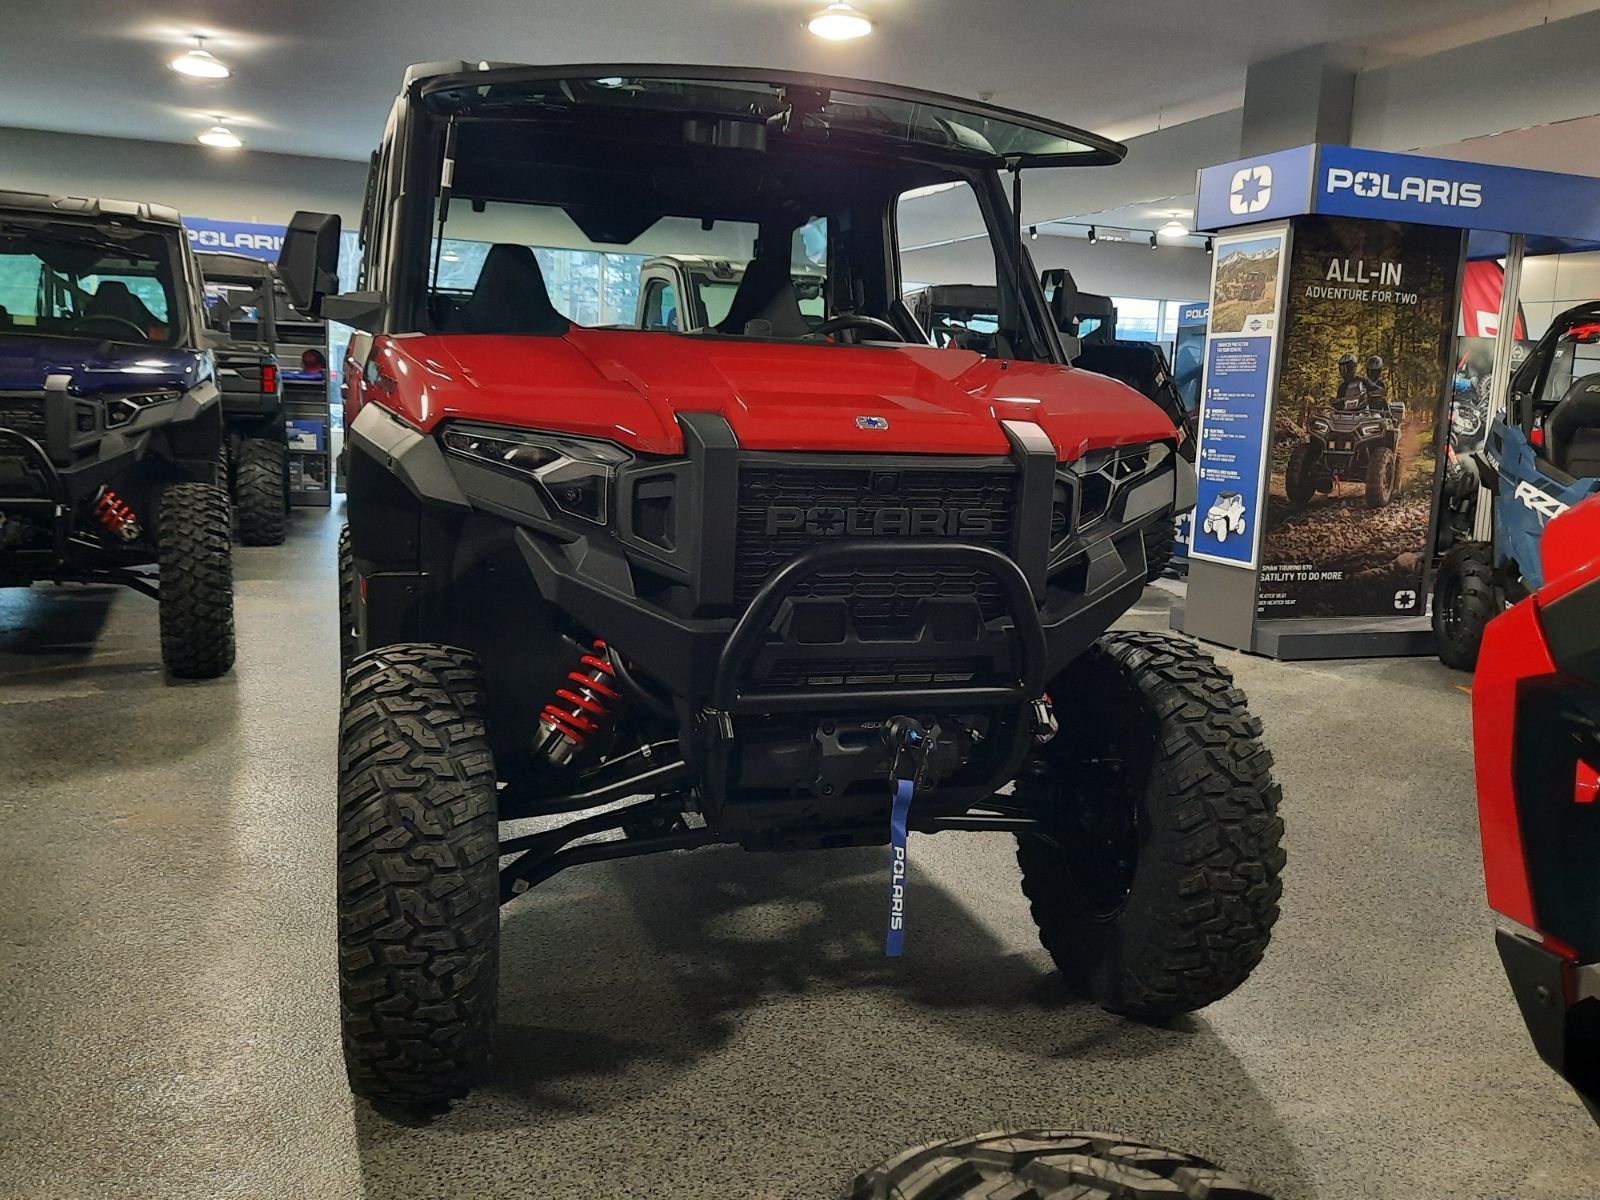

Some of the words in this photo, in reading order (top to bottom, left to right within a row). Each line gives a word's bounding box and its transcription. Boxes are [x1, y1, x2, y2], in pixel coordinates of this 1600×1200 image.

[1327, 168, 1483, 208] POLARIS
[1326, 258, 1402, 286] ALL-IN
[1305, 286, 1370, 301] ADVENTURE
[1371, 290, 1393, 303] FOR
[1395, 292, 1418, 305] TWO
[1207, 388, 1212, 399] 1
[1205, 408, 1211, 419] 2
[1203, 428, 1209, 438] 3
[1201, 448, 1207, 458] 4
[1486, 451, 1500, 471] TRAIL
[1200, 467, 1206, 478] 5
[765, 506, 993, 536] POLARIS
[1297, 573, 1307, 581] TO
[1308, 572, 1319, 581] DO
[1321, 571, 1343, 580] MORE
[891, 846, 905, 930] POLARIS
